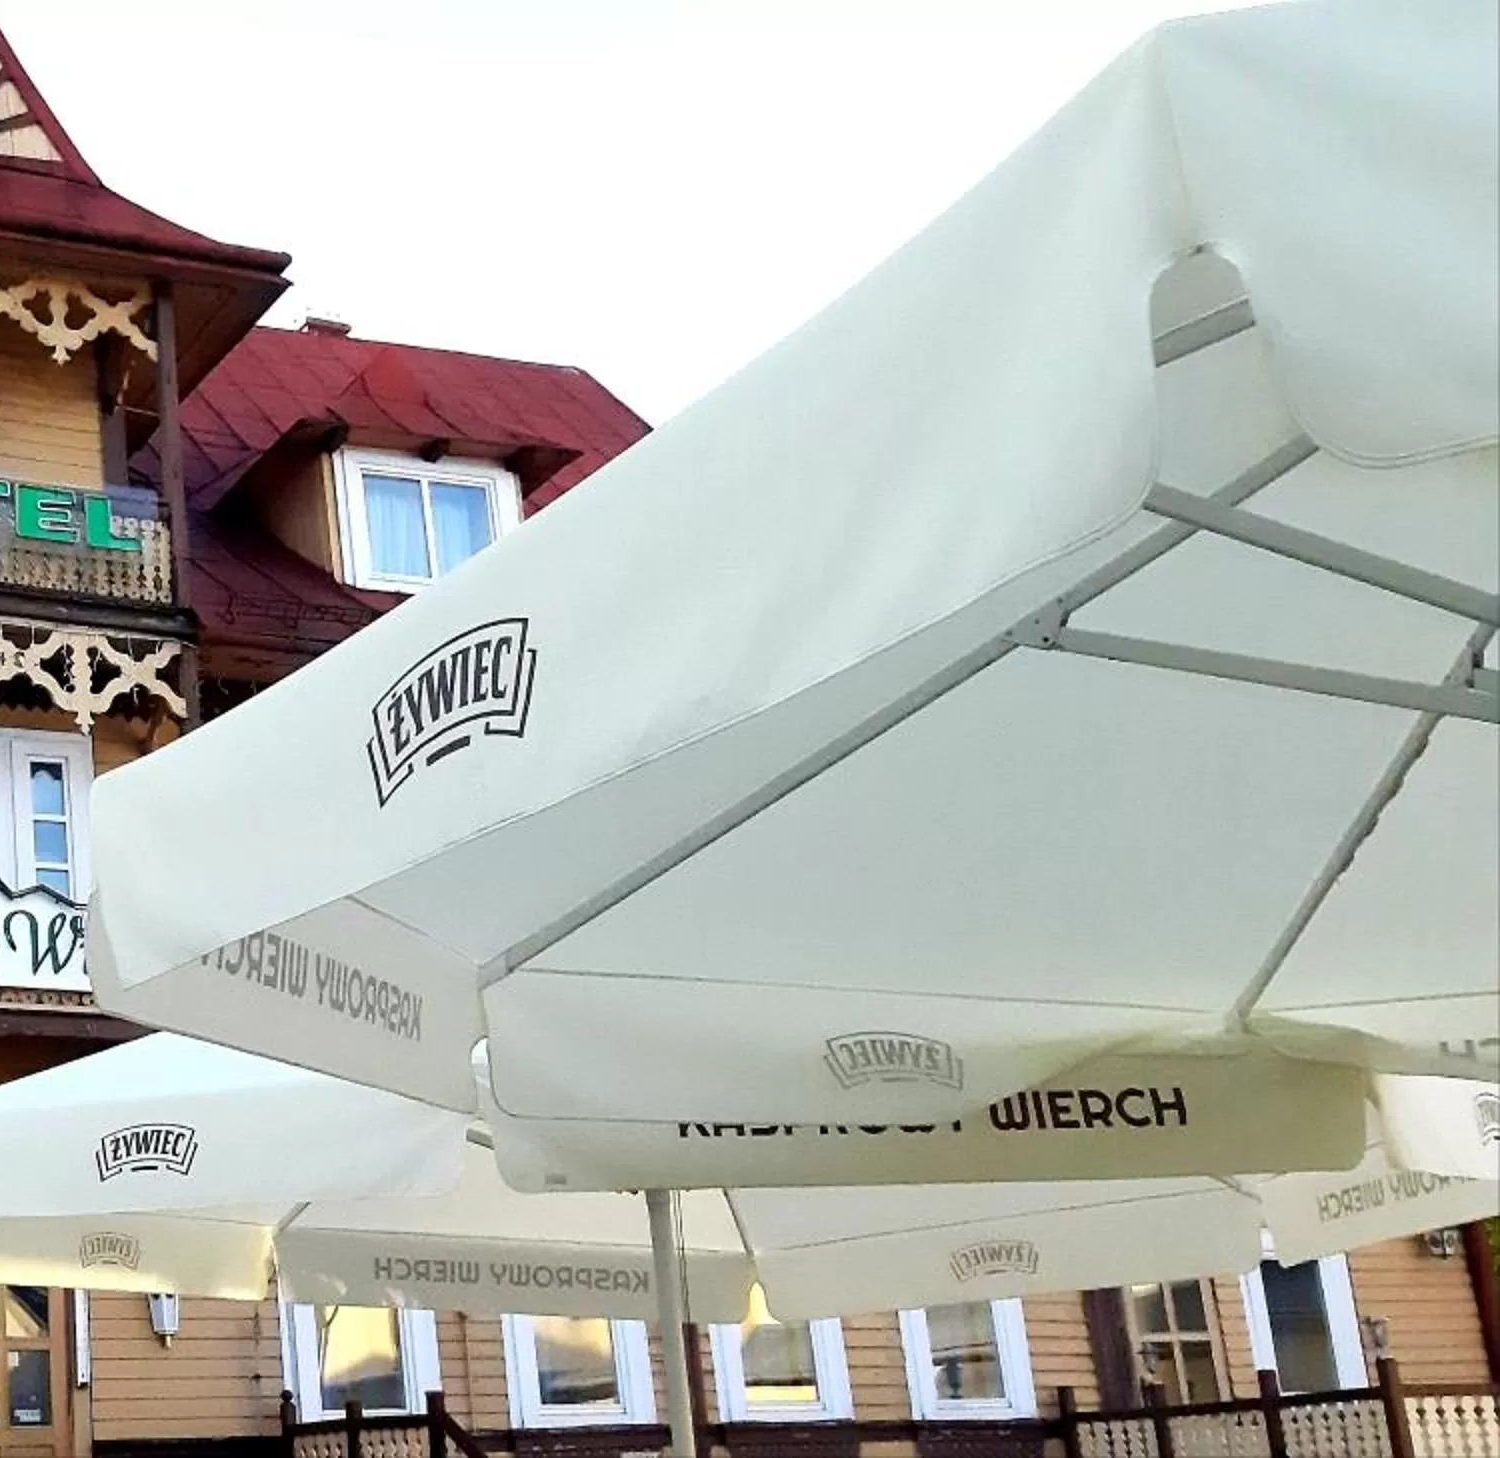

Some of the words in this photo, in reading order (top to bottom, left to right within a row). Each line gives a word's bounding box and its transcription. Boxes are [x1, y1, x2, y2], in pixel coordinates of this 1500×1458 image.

[387, 635, 513, 756] ŻYWIEC
[989, 1087, 1188, 1131] WIERCH
[109, 1129, 187, 1162] ŻYWIEC
